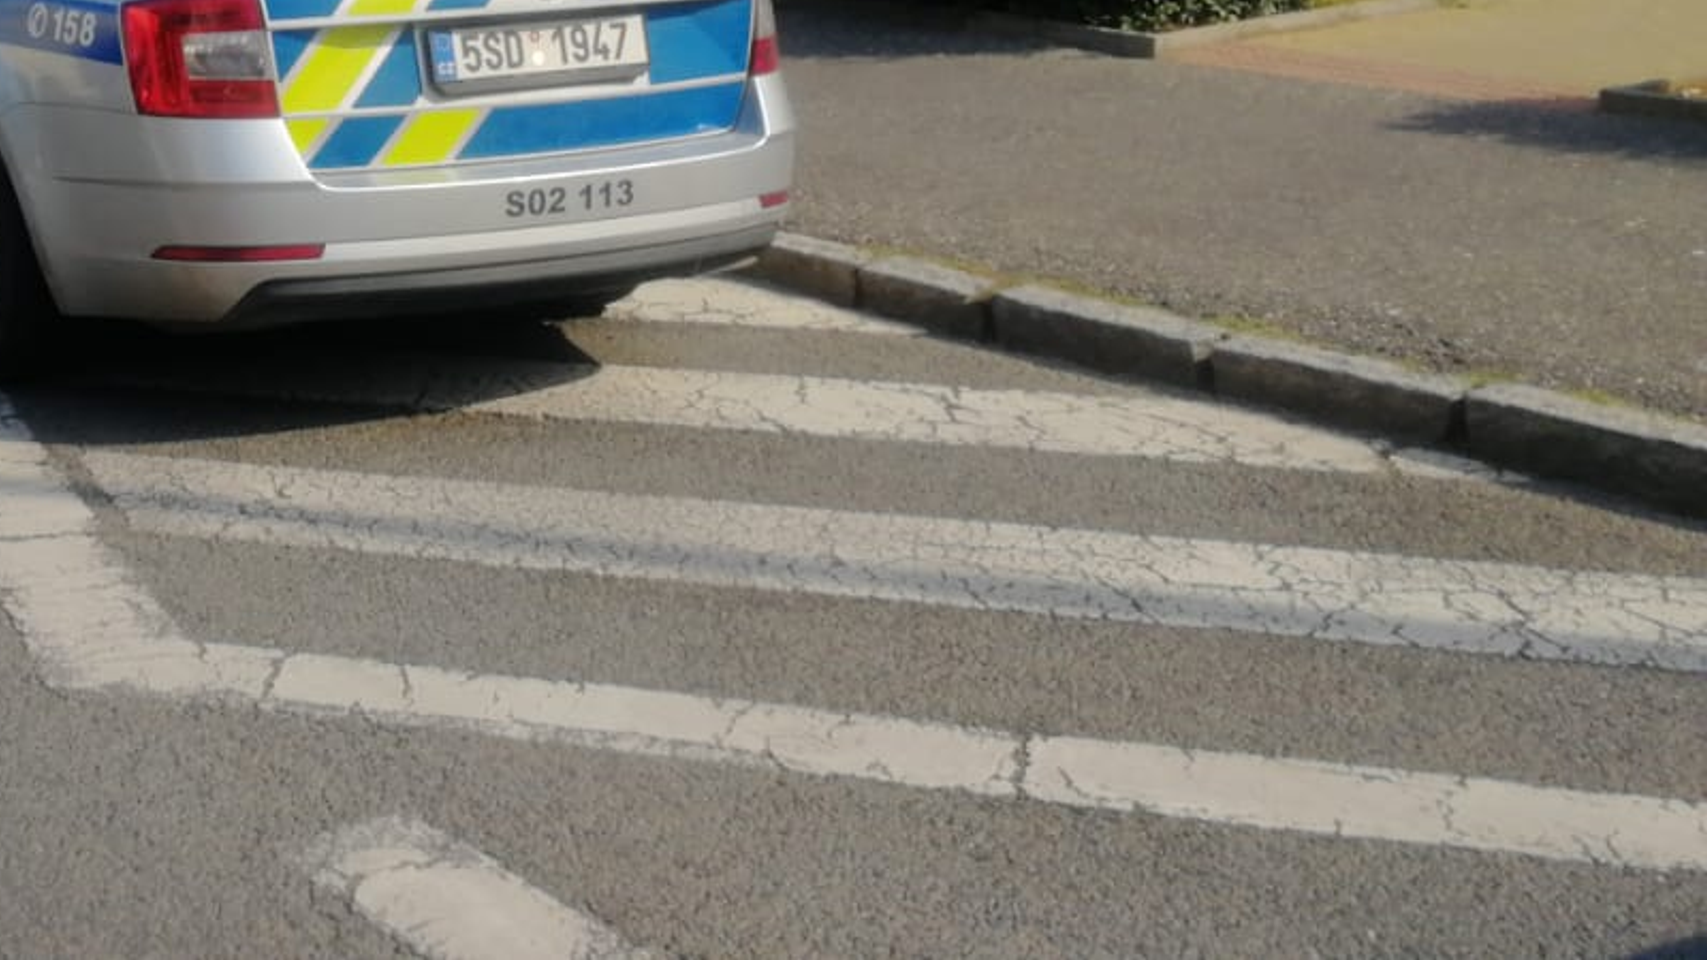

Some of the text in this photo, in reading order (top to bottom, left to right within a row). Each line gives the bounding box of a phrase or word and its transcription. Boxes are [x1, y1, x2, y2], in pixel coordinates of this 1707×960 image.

[53, 6, 97, 47] 158
[461, 22, 627, 72] 5SD 1947
[505, 179, 634, 217] S02 113
